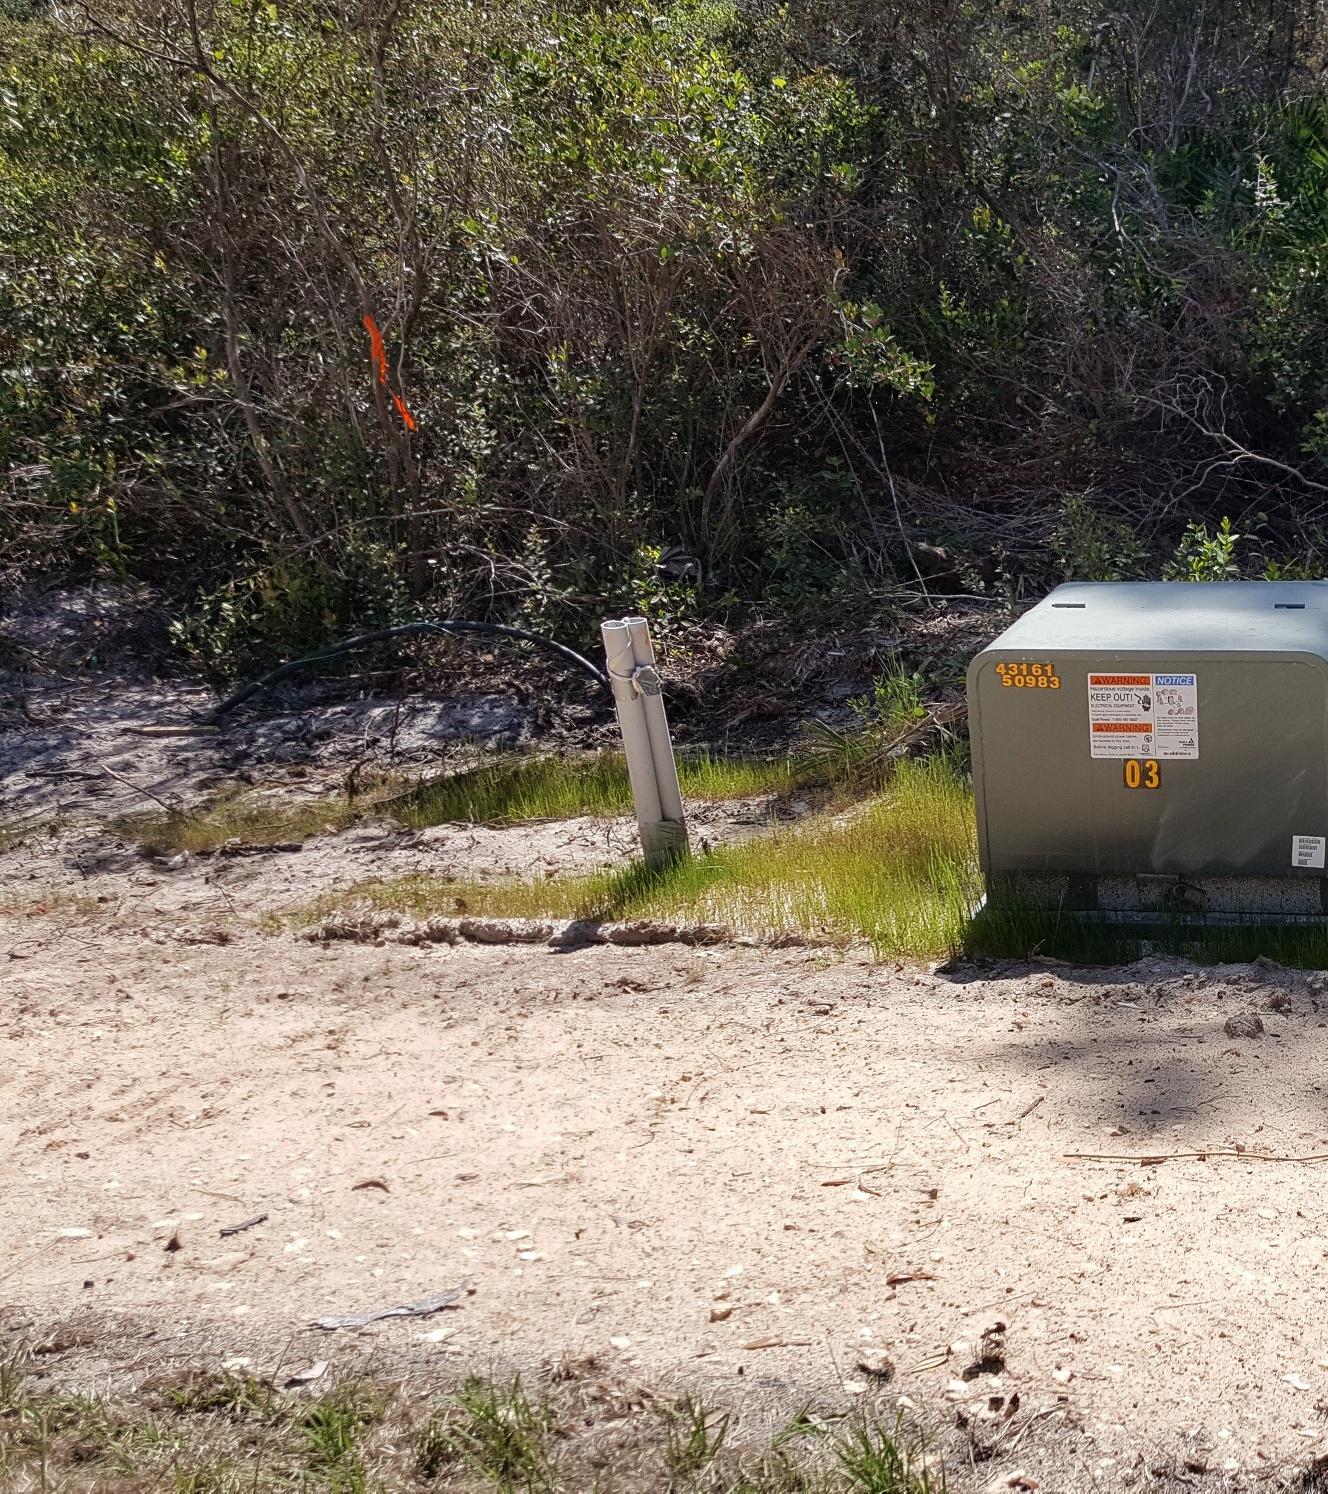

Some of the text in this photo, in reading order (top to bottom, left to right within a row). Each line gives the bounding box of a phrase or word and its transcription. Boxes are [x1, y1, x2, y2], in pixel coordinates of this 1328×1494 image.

[996, 663, 1053, 676] 43161
[1002, 674, 1060, 688] 50983
[1101, 676, 1147, 685] WARNING
[1157, 676, 1192, 685] NOTICE
[1090, 693, 1133, 701] KEEP OUT!
[1103, 724, 1148, 732] WARNING
[1126, 760, 1159, 788] 03
